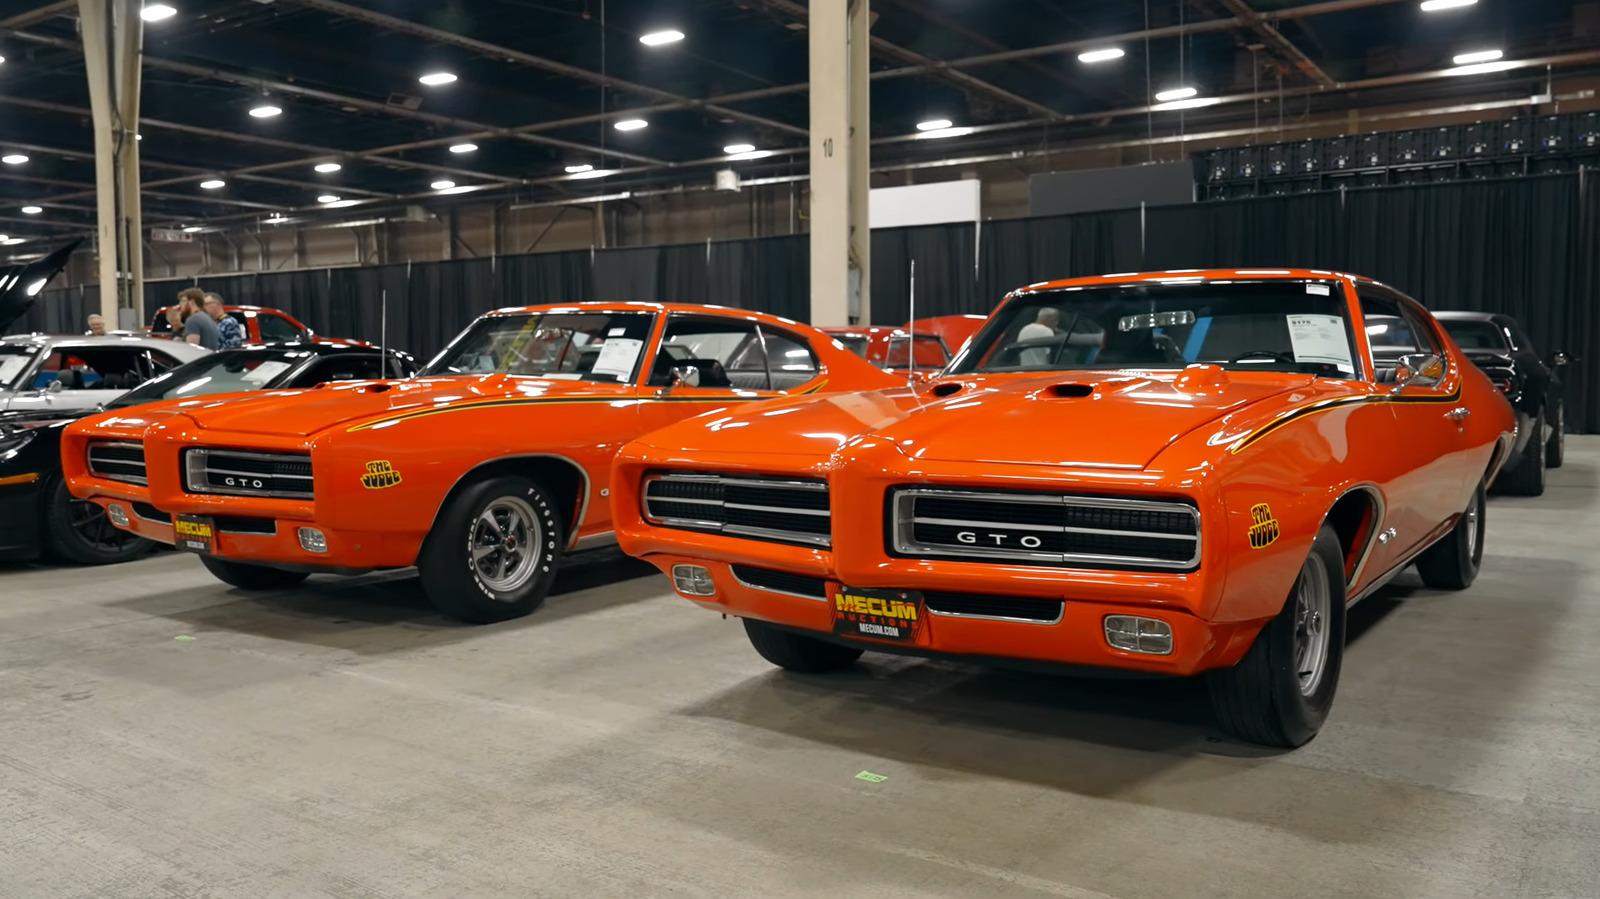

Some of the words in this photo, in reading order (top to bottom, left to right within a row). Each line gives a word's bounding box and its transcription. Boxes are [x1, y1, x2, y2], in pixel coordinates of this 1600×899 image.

[823, 138, 833, 158] 10
[366, 460, 391, 474] THE
[225, 477, 262, 488] GTO
[361, 471, 401, 488] JUDGE
[1252, 503, 1272, 524] THE
[175, 520, 211, 537] MECUM
[1249, 519, 1280, 548] JUDGE
[957, 531, 1041, 548] GTO
[835, 593, 917, 620] MECUM
[859, 622, 900, 637] MECUM.COM
